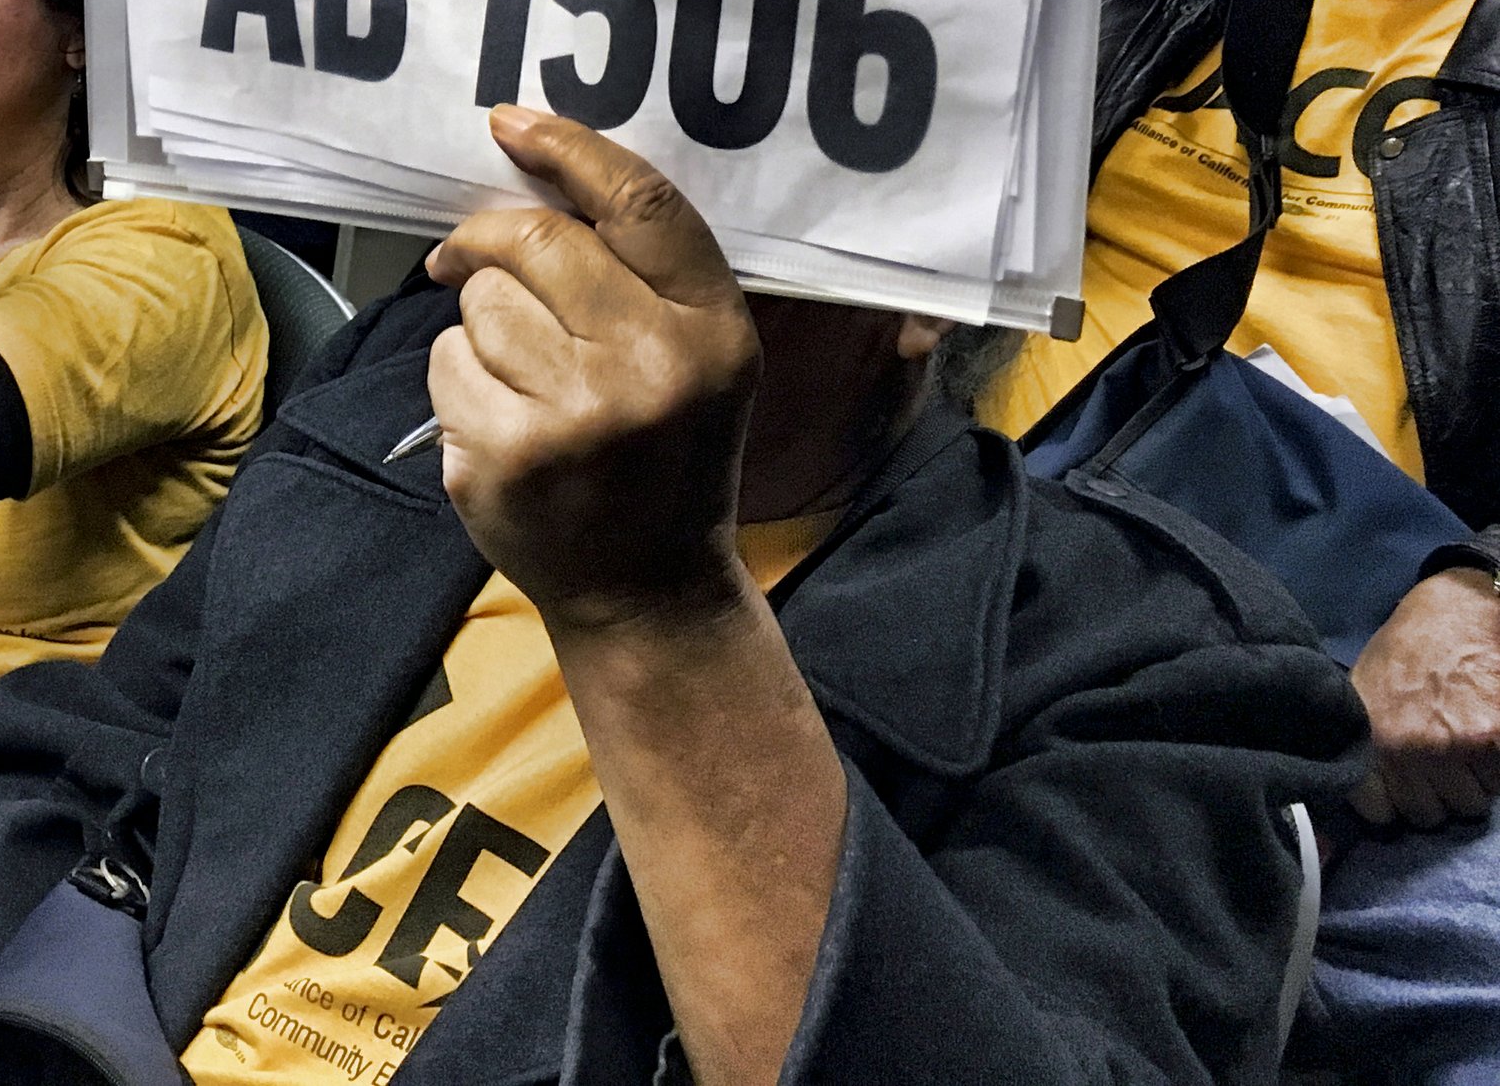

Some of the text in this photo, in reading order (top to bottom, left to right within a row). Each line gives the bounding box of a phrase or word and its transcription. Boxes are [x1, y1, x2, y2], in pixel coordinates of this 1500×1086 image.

[1132, 120, 1178, 149] Alliance
[1180, 146, 1197, 157] of
[1198, 153, 1250, 189] Californ
[248, 992, 373, 1082] Community
[341, 1002, 369, 1027] of
